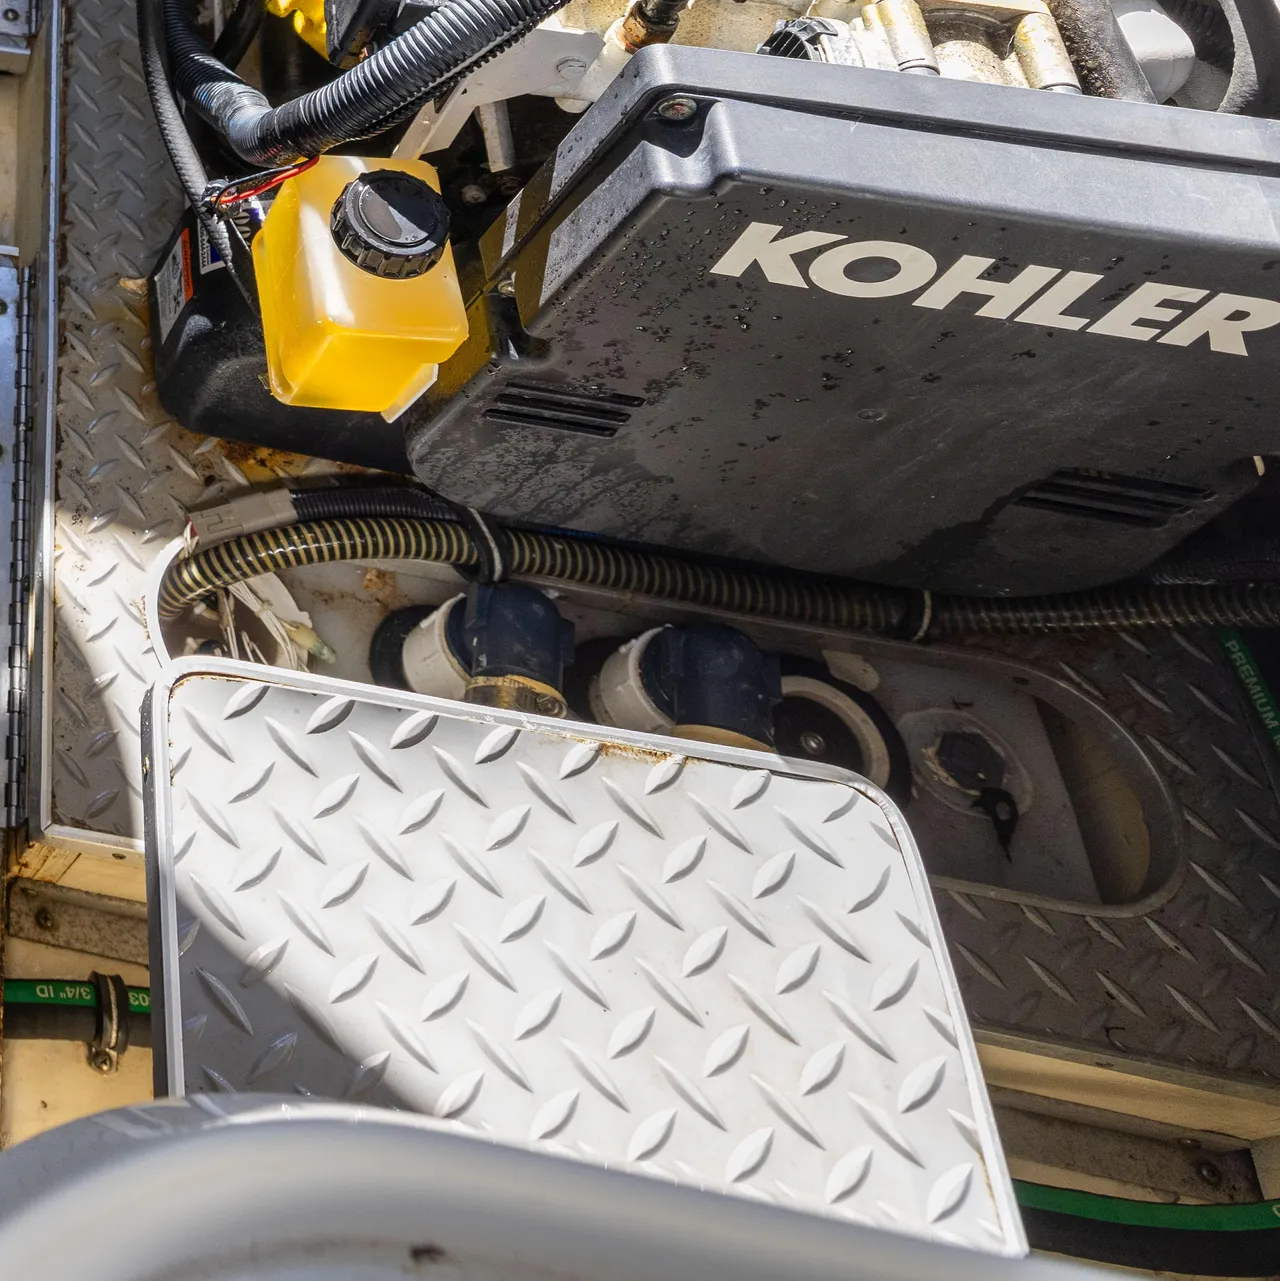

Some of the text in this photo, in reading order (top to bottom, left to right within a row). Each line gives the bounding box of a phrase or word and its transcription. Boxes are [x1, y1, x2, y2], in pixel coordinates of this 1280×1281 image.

[709, 220, 1280, 357] KOHLER
[1224, 638, 1279, 730] PREMIUM
[36, 985, 54, 998] ID
